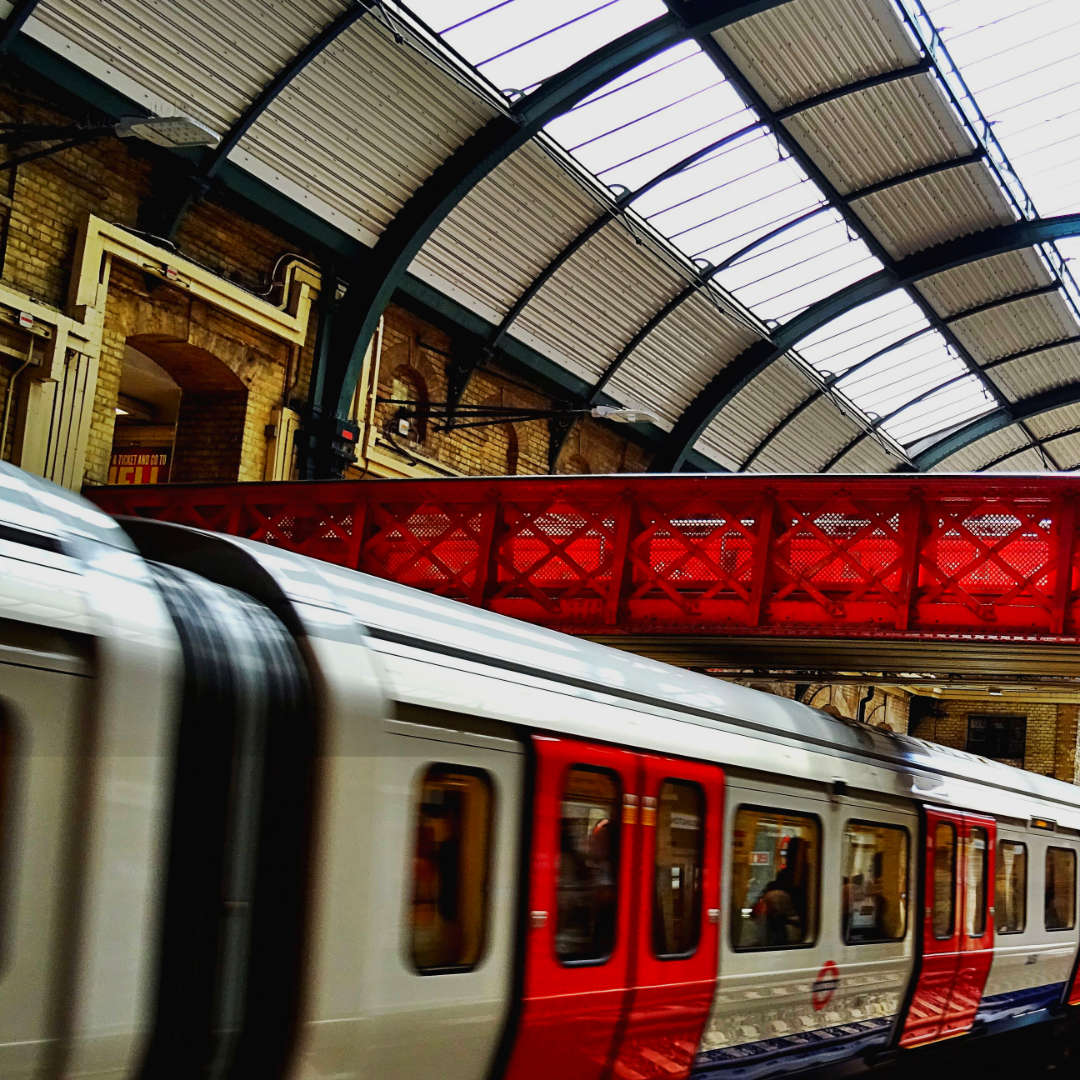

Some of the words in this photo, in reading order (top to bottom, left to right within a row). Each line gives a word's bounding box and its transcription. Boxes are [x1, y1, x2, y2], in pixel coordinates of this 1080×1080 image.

[118, 454, 137, 465] TICKET
[137, 454, 150, 465] AND
[150, 454, 159, 465] GO
[159, 454, 167, 465] TO
